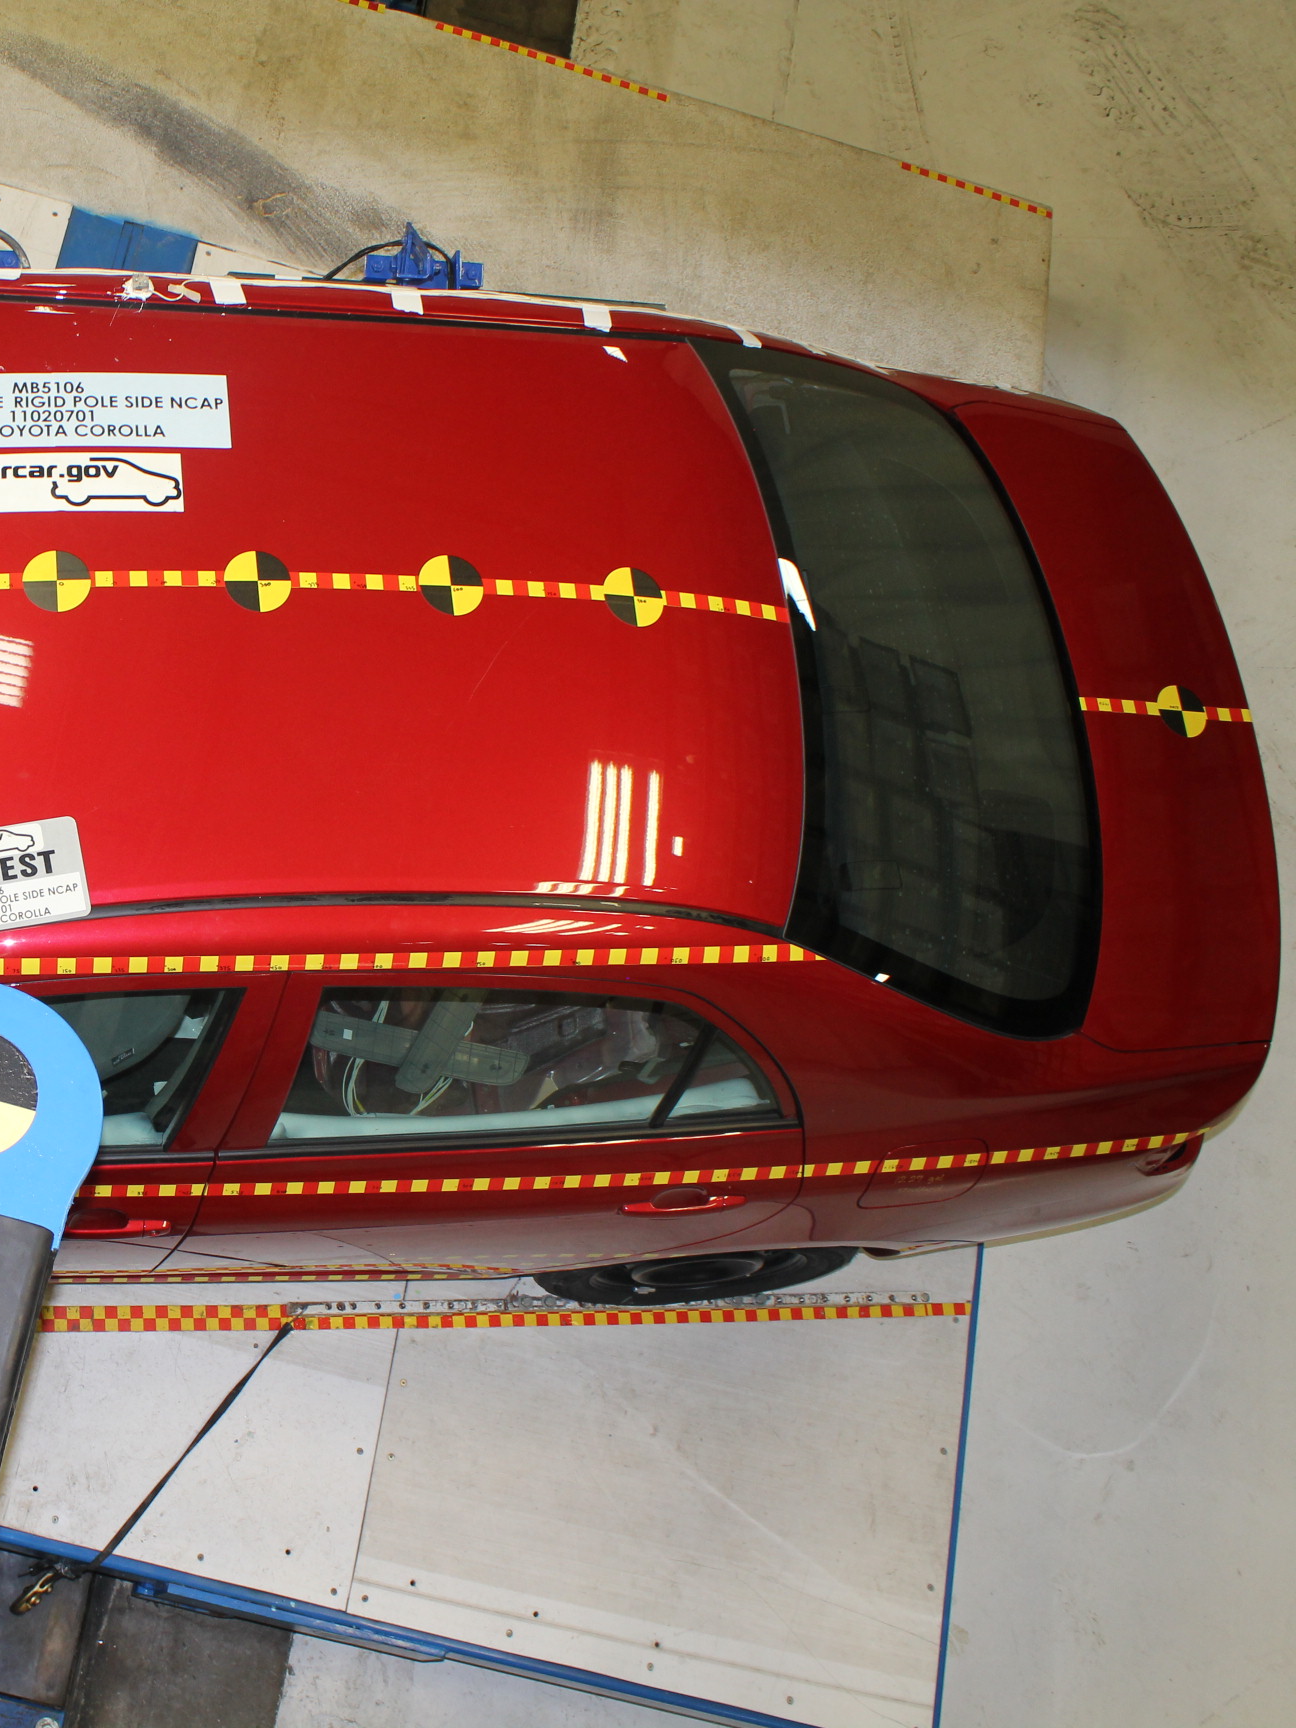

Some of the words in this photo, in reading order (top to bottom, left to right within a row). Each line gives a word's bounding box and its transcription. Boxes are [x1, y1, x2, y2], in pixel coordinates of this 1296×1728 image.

[12, 381, 85, 395] MB5106
[14, 395, 67, 409] RIGID
[73, 395, 120, 409] POLE
[125, 395, 164, 410] SIDE
[170, 396, 224, 411] NCAP
[9, 410, 95, 423] 11020701
[74, 423, 166, 438] COROLLA
[22, 888, 45, 901] SIDE
[48, 883, 79, 896] NCAP
[0, 906, 52, 923] COROLLA
